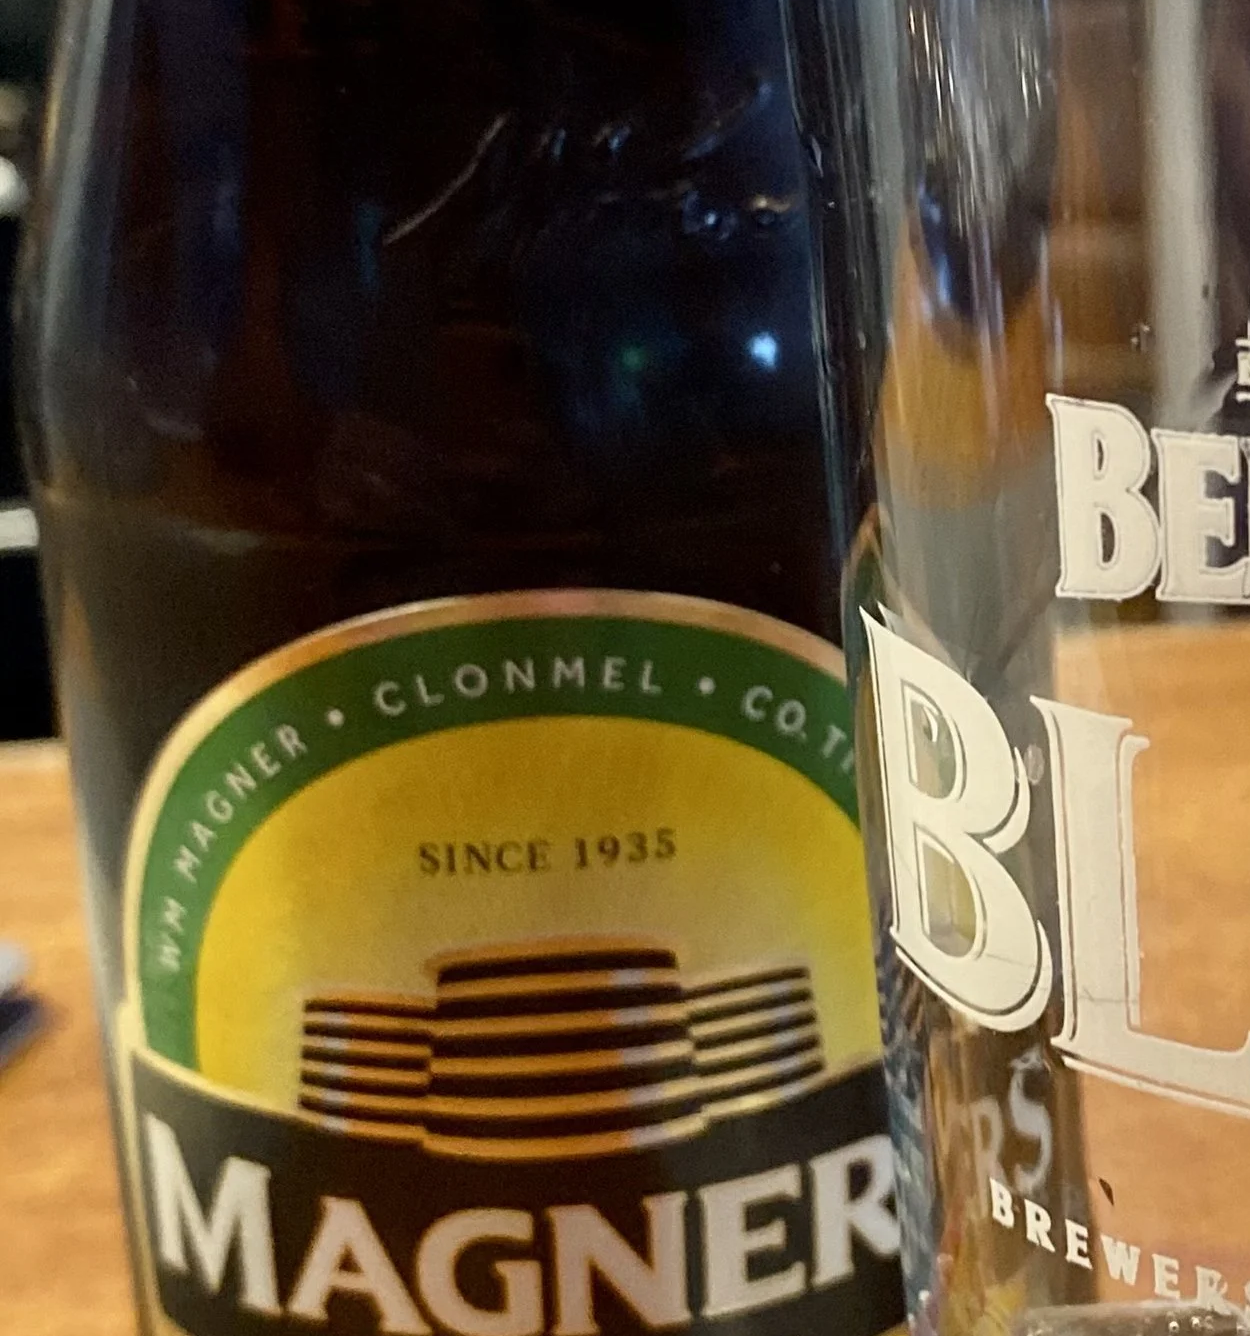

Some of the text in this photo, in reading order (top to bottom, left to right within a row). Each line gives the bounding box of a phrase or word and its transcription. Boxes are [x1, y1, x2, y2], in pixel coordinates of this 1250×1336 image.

[173, 723, 309, 884] MAGNER
[372, 655, 664, 717] CLONMEL
[417, 826, 679, 878] SINCE 1935
